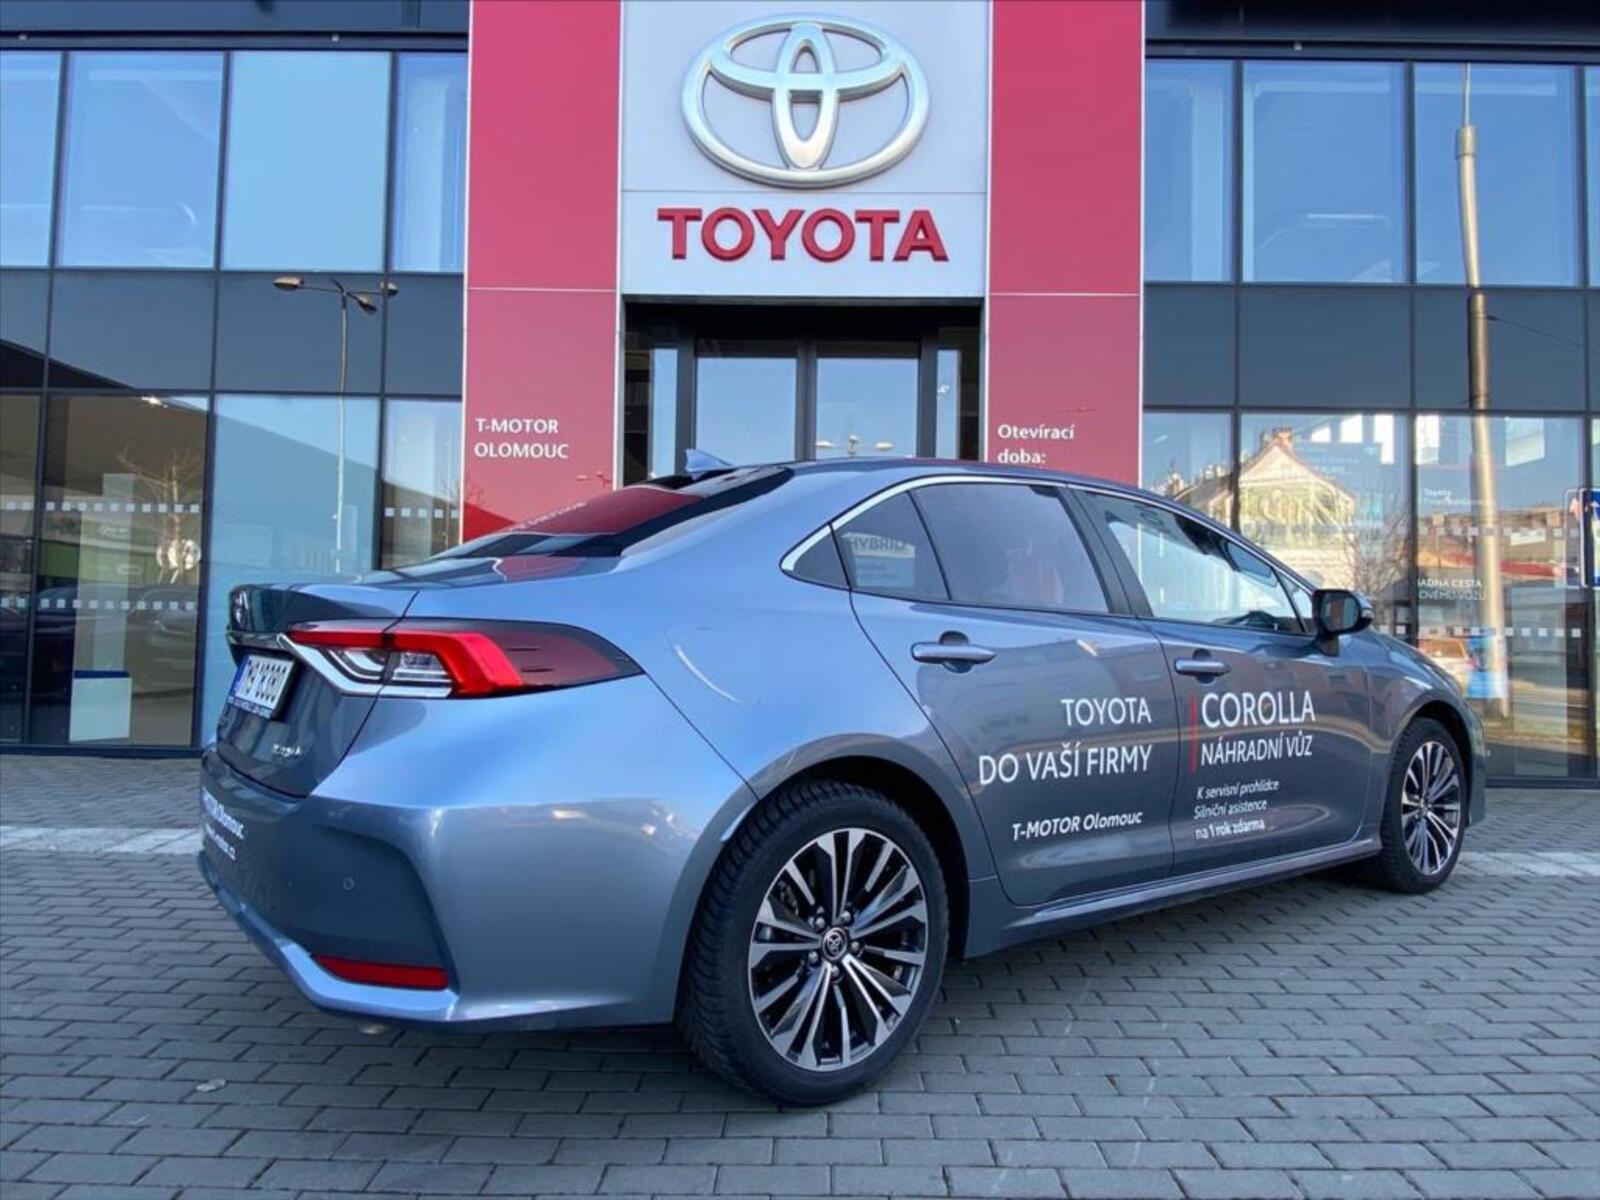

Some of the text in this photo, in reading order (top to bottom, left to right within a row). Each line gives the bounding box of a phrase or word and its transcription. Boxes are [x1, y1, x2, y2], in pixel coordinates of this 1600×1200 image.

[657, 207, 949, 263] TOYOTA
[475, 418, 559, 434] T-MOTOR
[997, 423, 1075, 439] Otevírací
[474, 442, 569, 459] OLOMOUC
[997, 448, 1046, 464] doba:
[1061, 697, 1152, 726] TOYOTA
[1201, 690, 1316, 728] COROLLA
[1201, 730, 1313, 766] NÁHRADNÍ VŮZ
[978, 741, 1152, 785] DO VAŠÍ FIRMY
[1197, 786, 1204, 800] K
[1228, 799, 1267, 815] asistence
[1012, 812, 1143, 842] T-MOTOR Olomouc
[1195, 828, 1209, 839] na
[1233, 818, 1265, 834] zdarma
